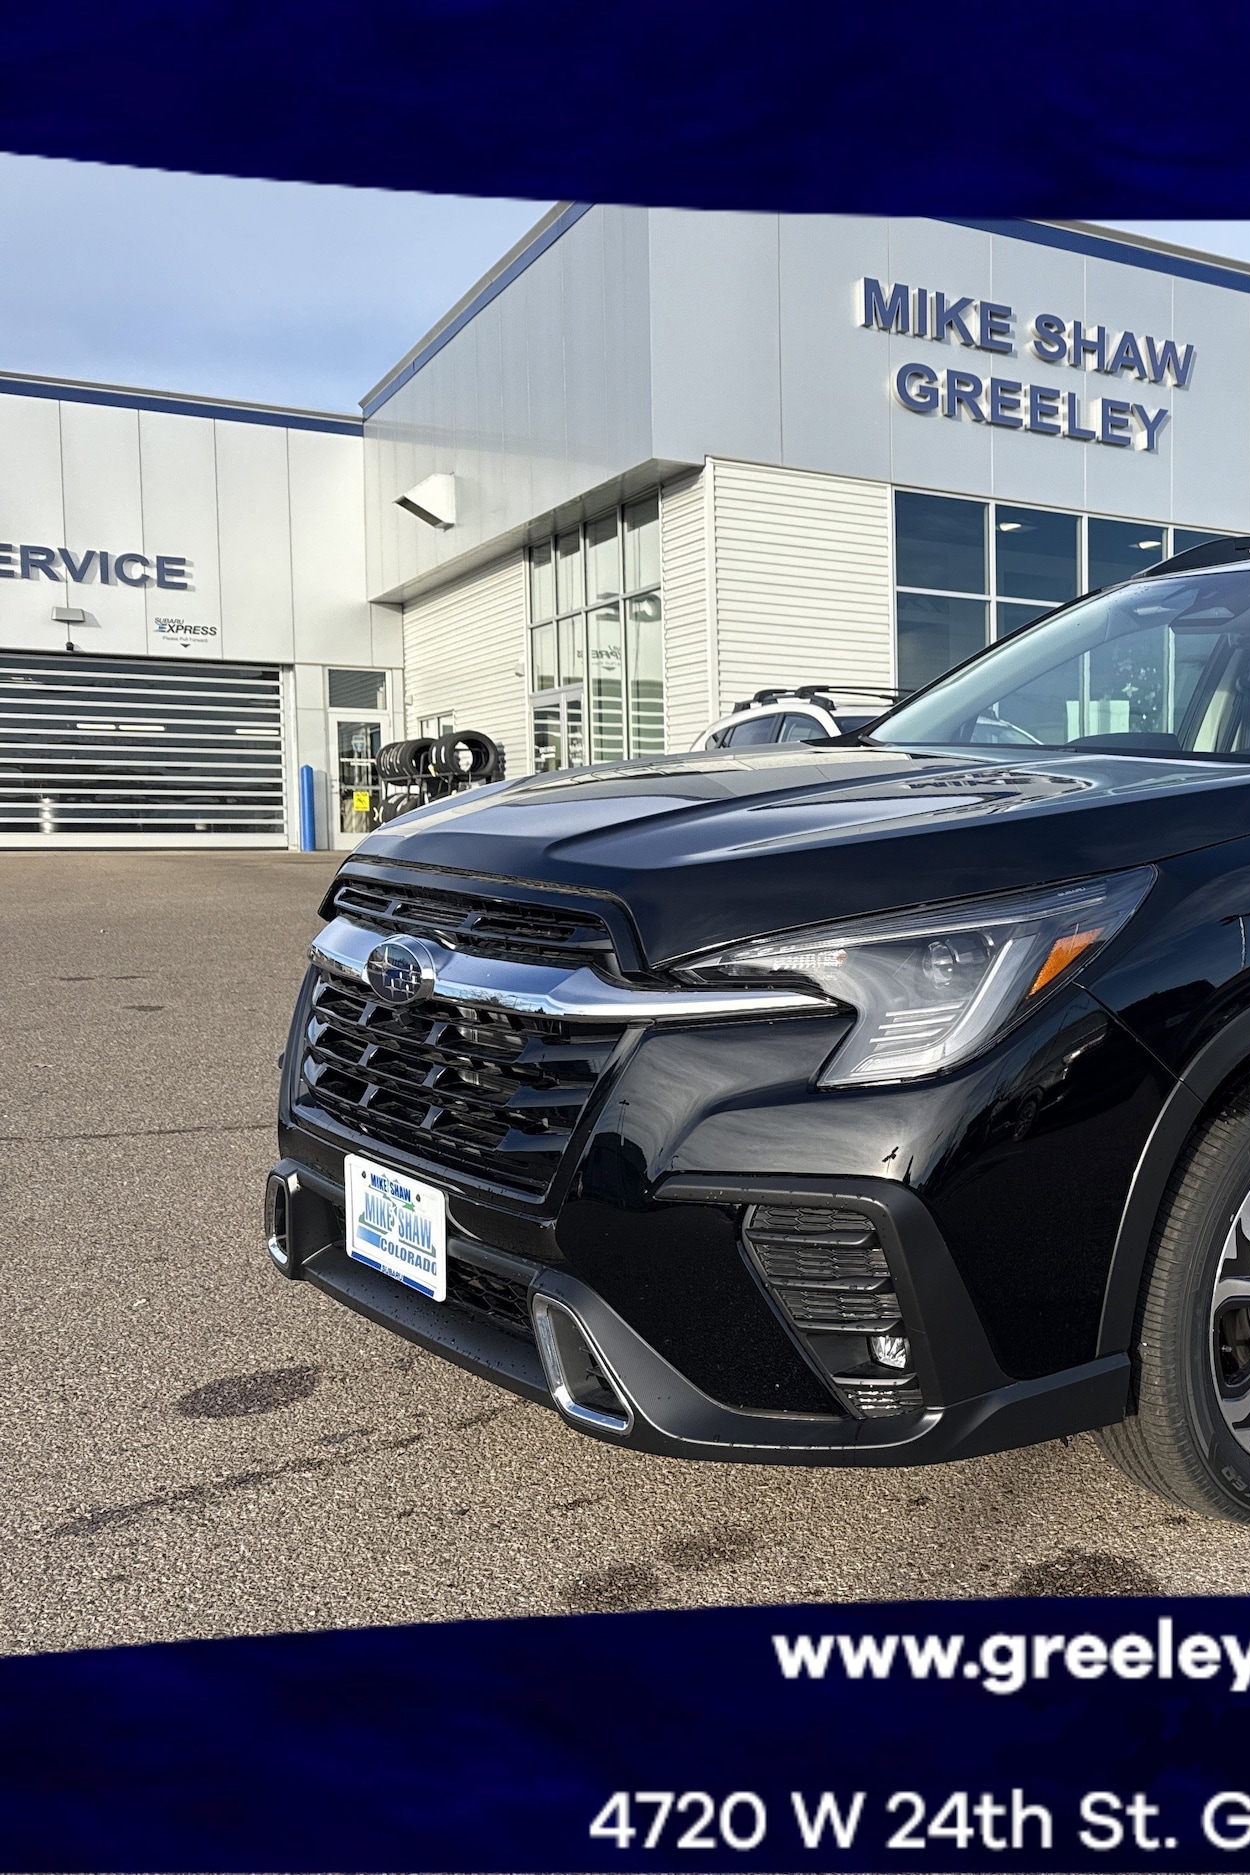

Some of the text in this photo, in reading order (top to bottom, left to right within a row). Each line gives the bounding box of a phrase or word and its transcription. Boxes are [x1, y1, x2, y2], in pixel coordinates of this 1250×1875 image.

[861, 276, 1195, 388] MIKE SHAW
[894, 362, 1169, 450] GREELEY
[154, 622, 218, 636] EXPRESS
[370, 1173, 411, 1203] MIKE SHAW
[364, 1192, 432, 1250] MIKE SHAW
[380, 1237, 437, 1276] COLORADO
[381, 1264, 404, 1282] SUBARU
